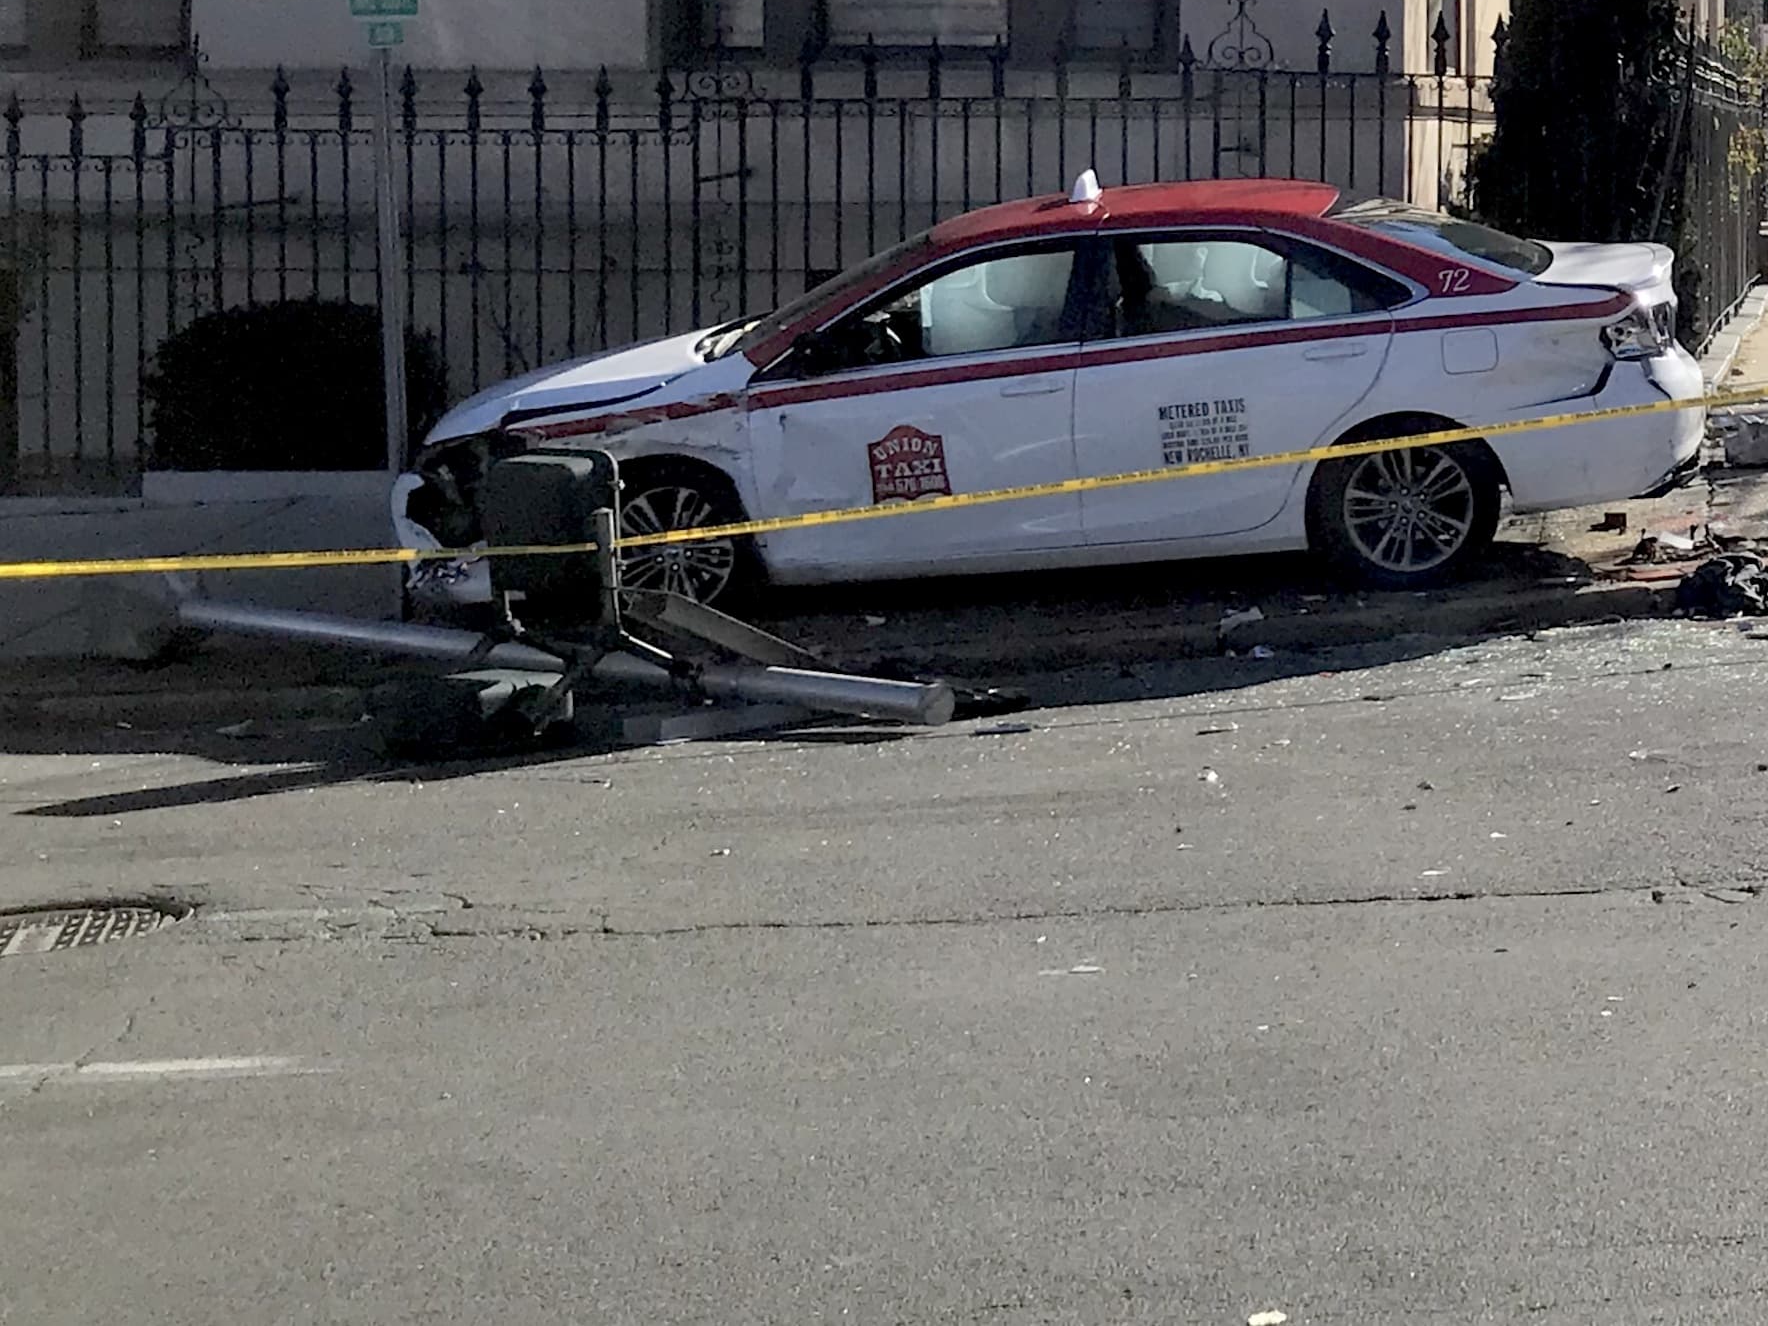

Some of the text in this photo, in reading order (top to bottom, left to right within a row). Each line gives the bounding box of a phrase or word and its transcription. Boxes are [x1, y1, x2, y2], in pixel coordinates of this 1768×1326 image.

[1438, 268, 1471, 293] 72
[1158, 397, 1246, 420] METERED TAXIS
[873, 437, 939, 460] UNION
[1163, 450, 1183, 465] NEW
[874, 458, 942, 478] TAXI
